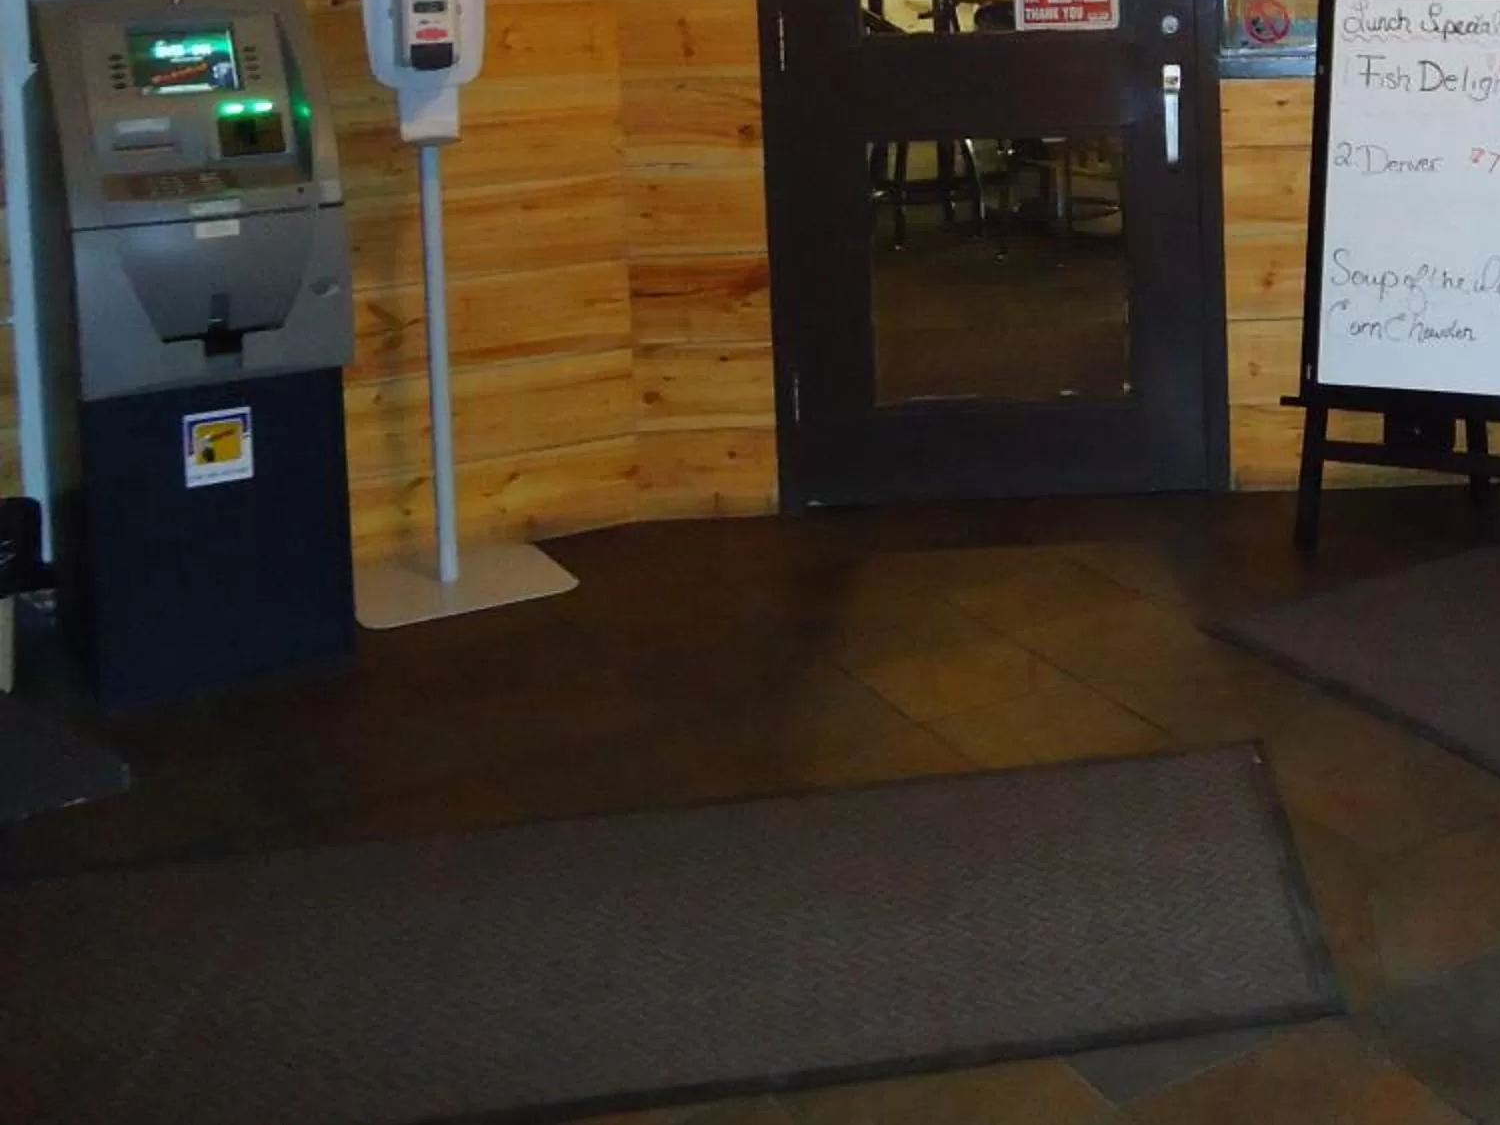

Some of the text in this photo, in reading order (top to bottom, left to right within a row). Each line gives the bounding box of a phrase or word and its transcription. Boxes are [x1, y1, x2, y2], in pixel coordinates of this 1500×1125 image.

[1356, 54, 1411, 92] Fish
[1355, 144, 1444, 176] Denver
[1331, 247, 1399, 300] Soup
[1404, 263, 1429, 315] of
